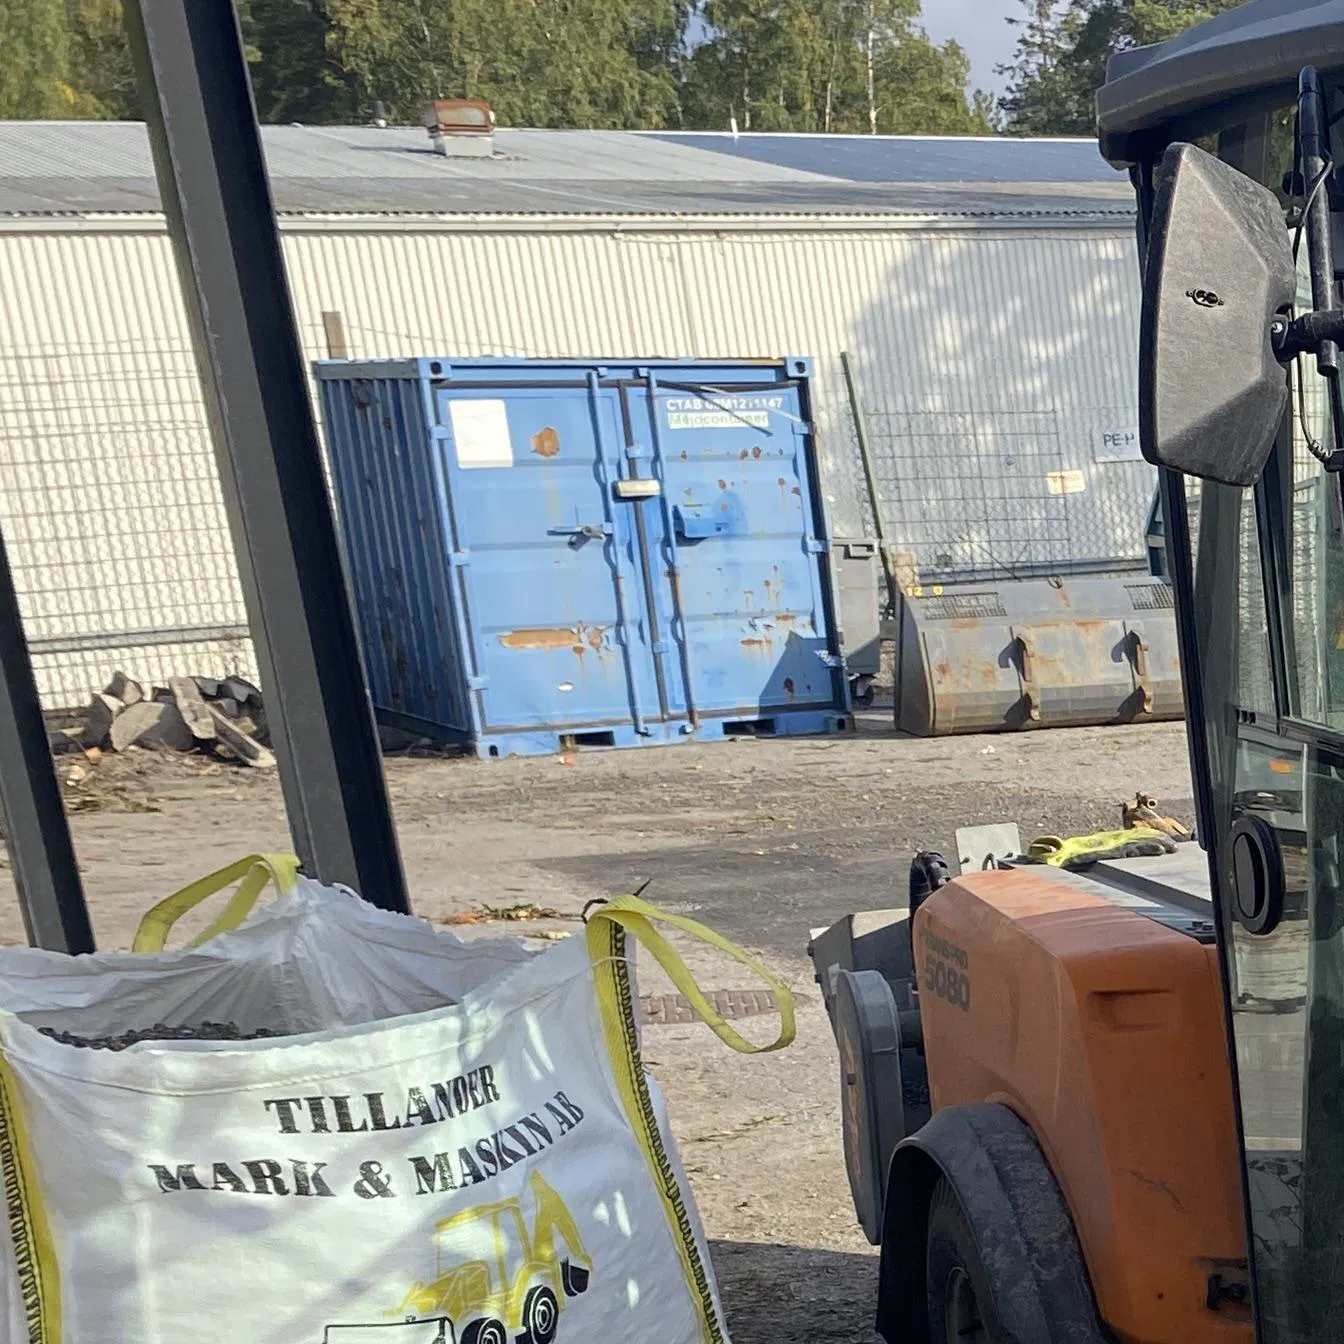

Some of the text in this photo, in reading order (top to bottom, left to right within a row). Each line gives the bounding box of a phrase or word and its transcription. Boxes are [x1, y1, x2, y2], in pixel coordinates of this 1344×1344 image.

[925, 953, 970, 1011] 5080
[147, 1091, 585, 1200] MARK & MASKIN AB
